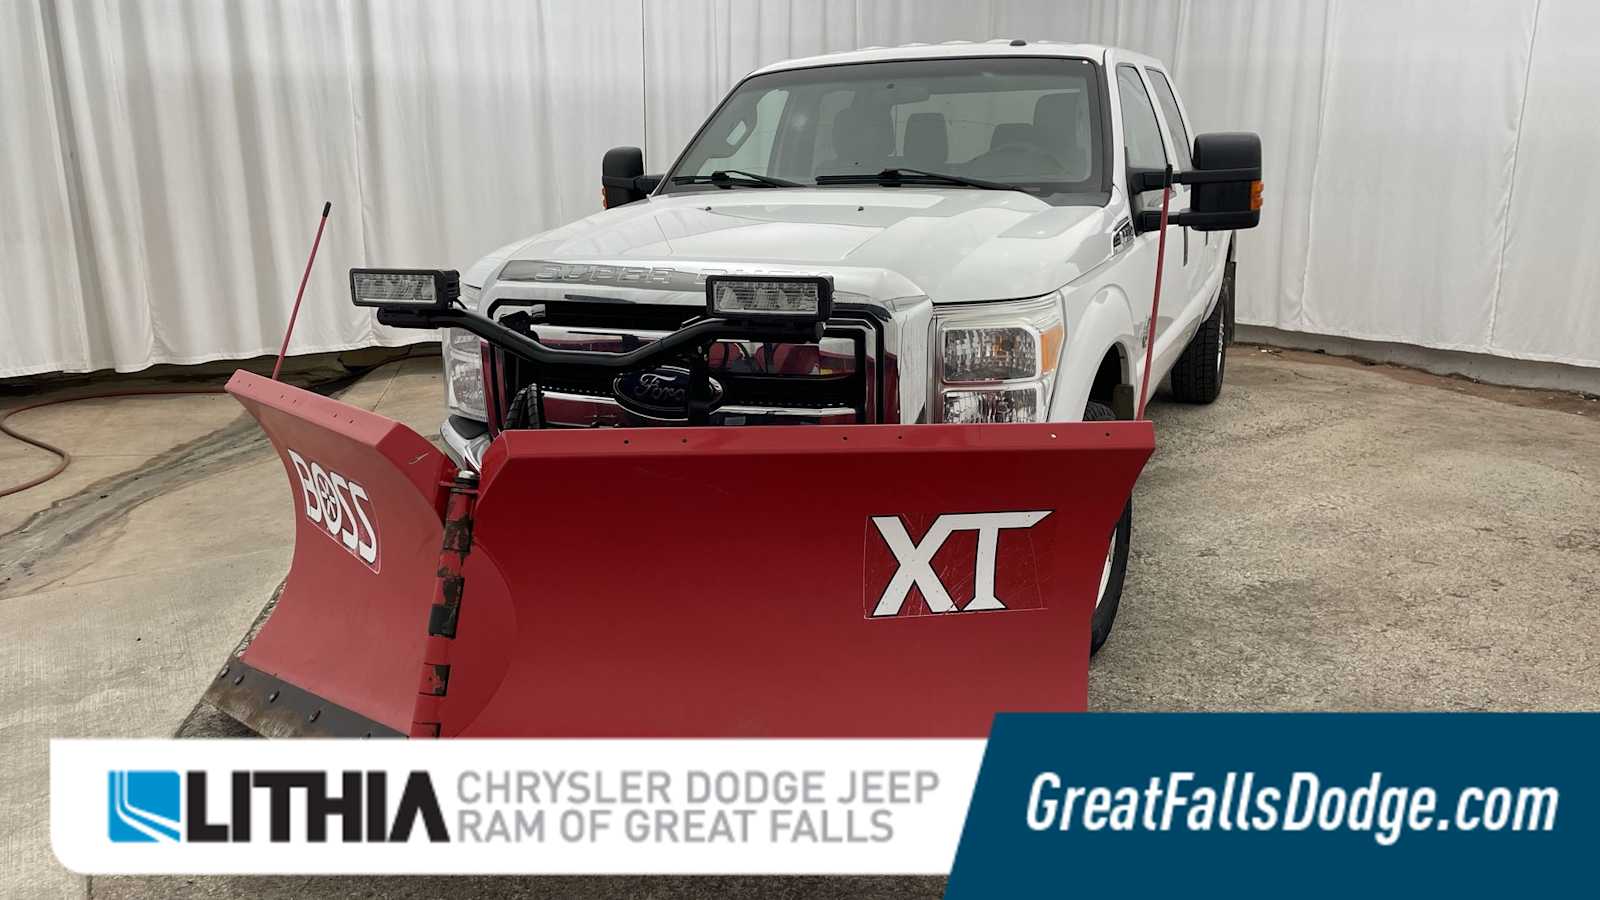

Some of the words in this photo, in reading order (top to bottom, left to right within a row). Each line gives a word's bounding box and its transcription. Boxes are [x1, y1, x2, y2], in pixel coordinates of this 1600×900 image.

[534, 264, 678, 285] SUPER
[287, 448, 378, 565] BOSS
[871, 509, 1055, 618] XT
